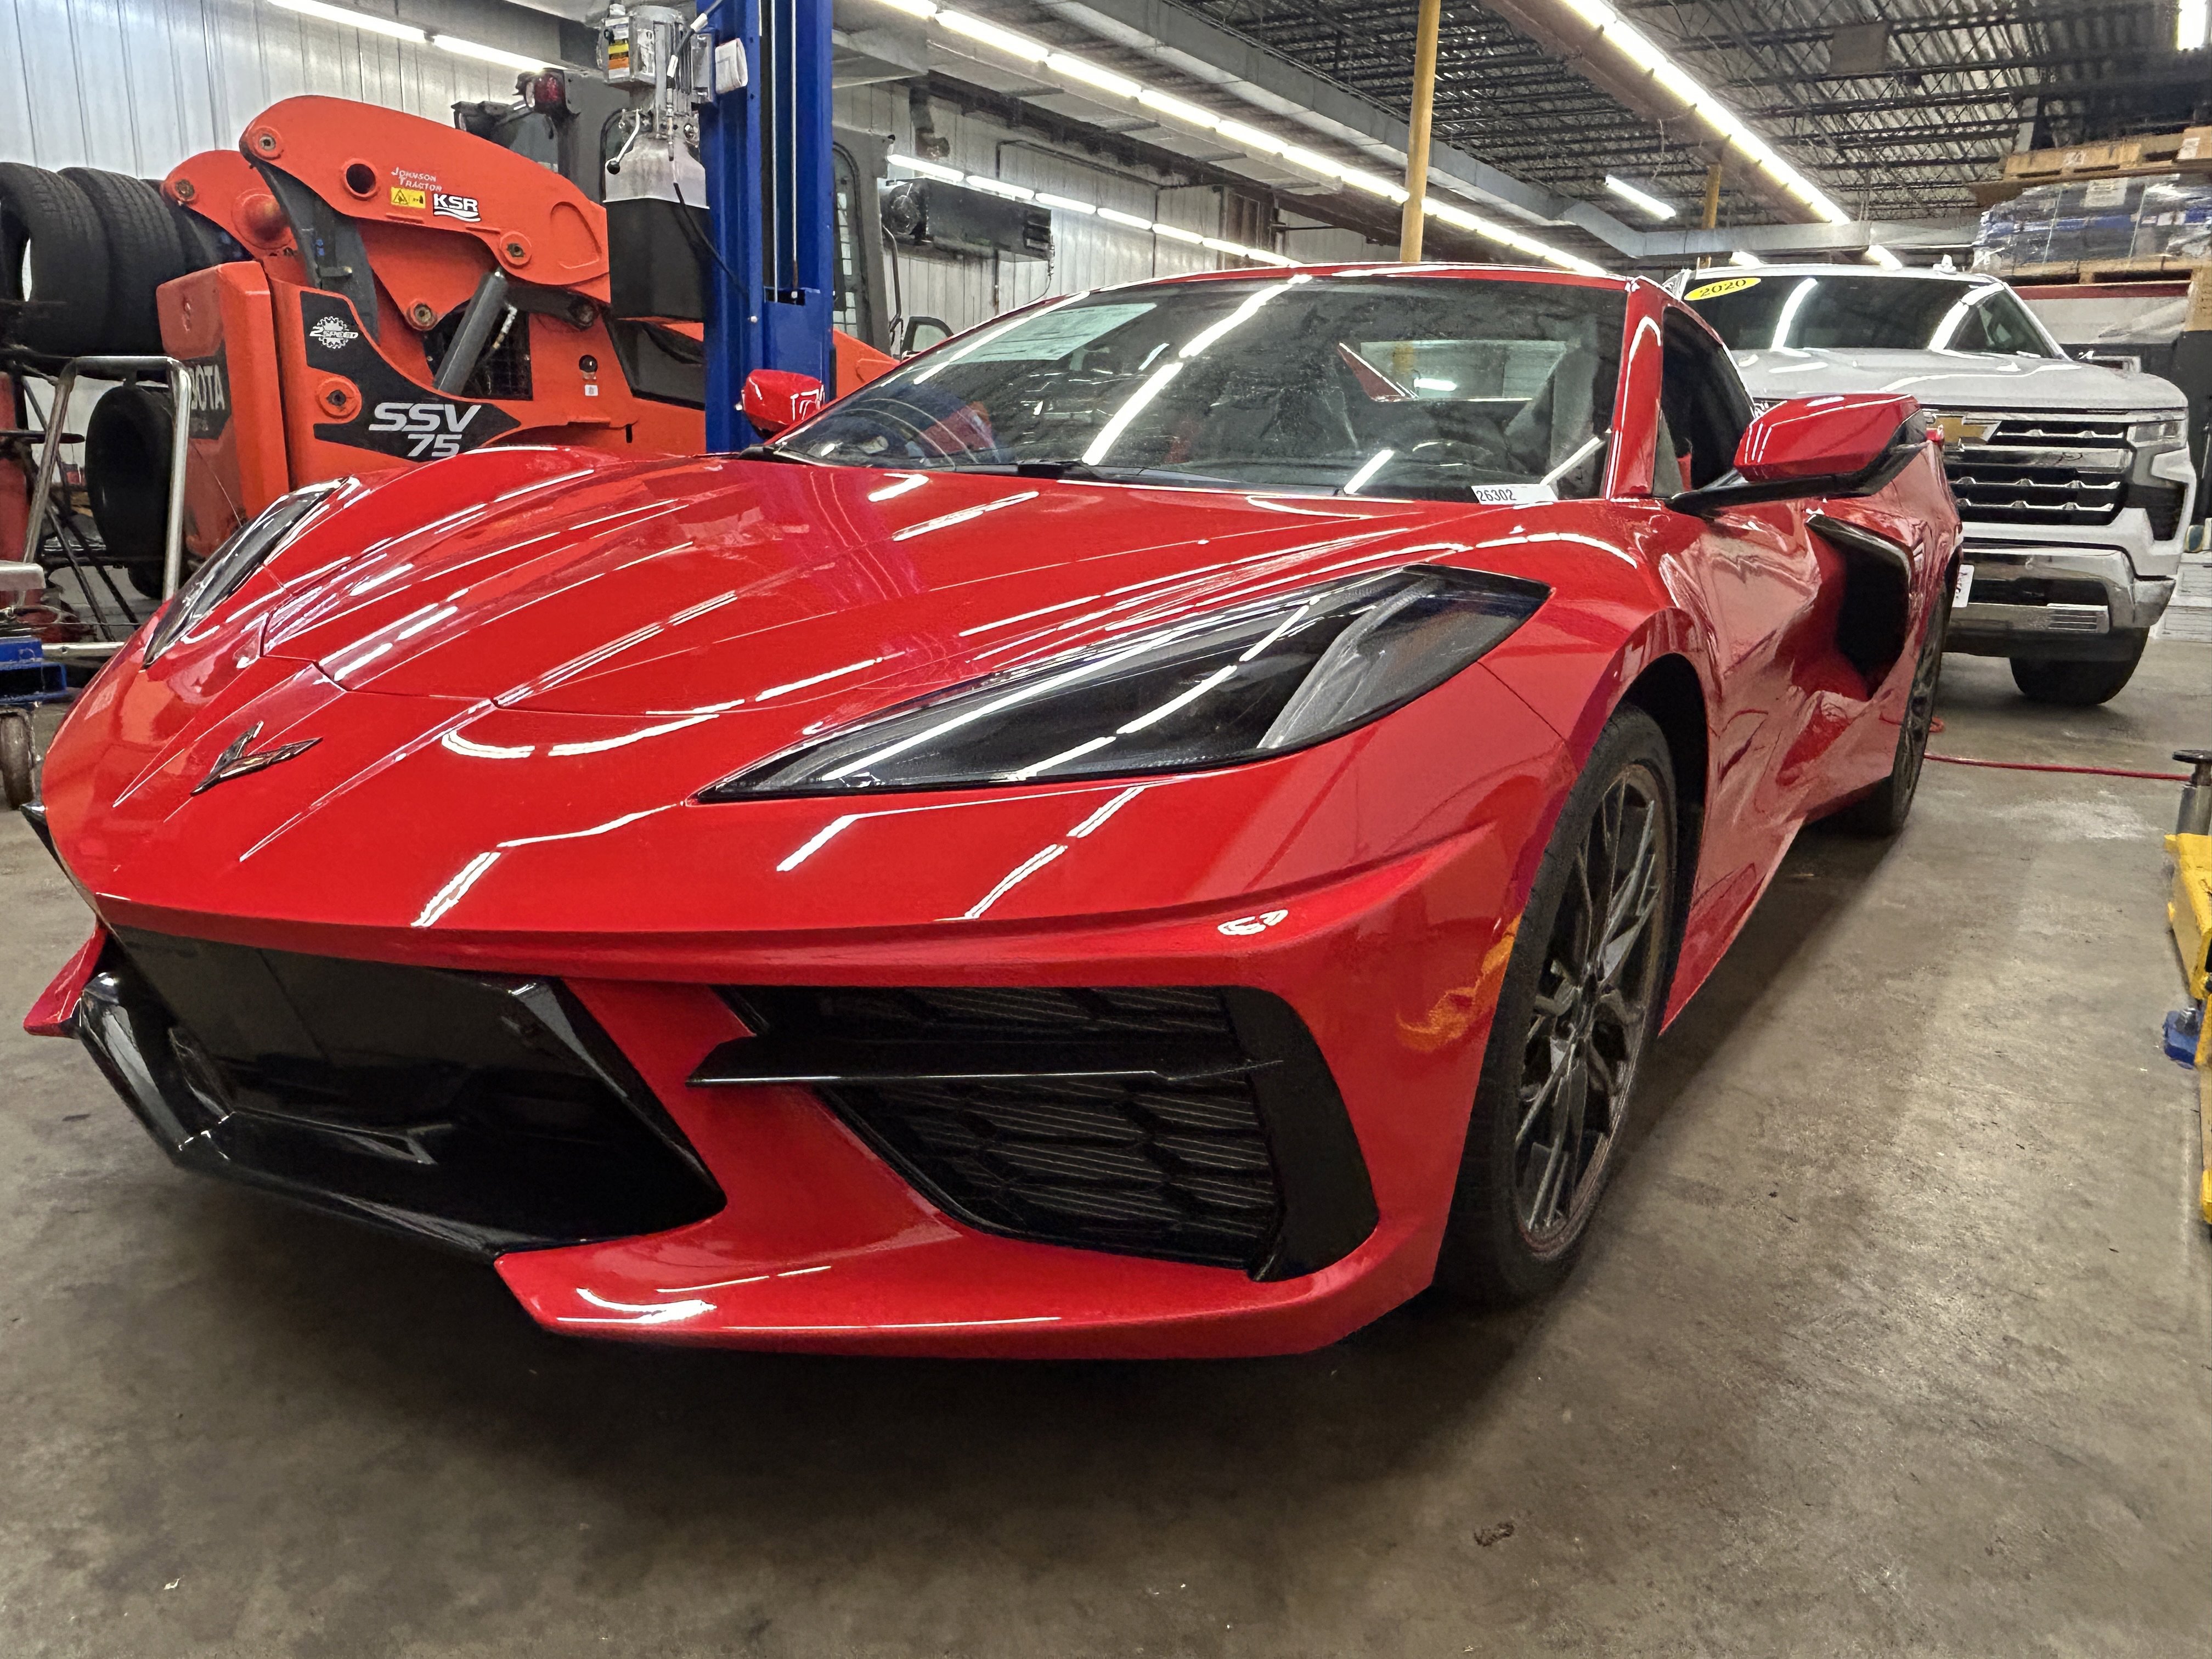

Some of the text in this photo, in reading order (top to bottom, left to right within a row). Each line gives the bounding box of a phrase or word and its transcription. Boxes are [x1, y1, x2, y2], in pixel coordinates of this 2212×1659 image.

[433, 193, 478, 212] KSR
[1700, 279, 1746, 297] 2020
[368, 402, 482, 432] SSV
[407, 433, 462, 457] 75
[1476, 489, 1517, 501] 26302
